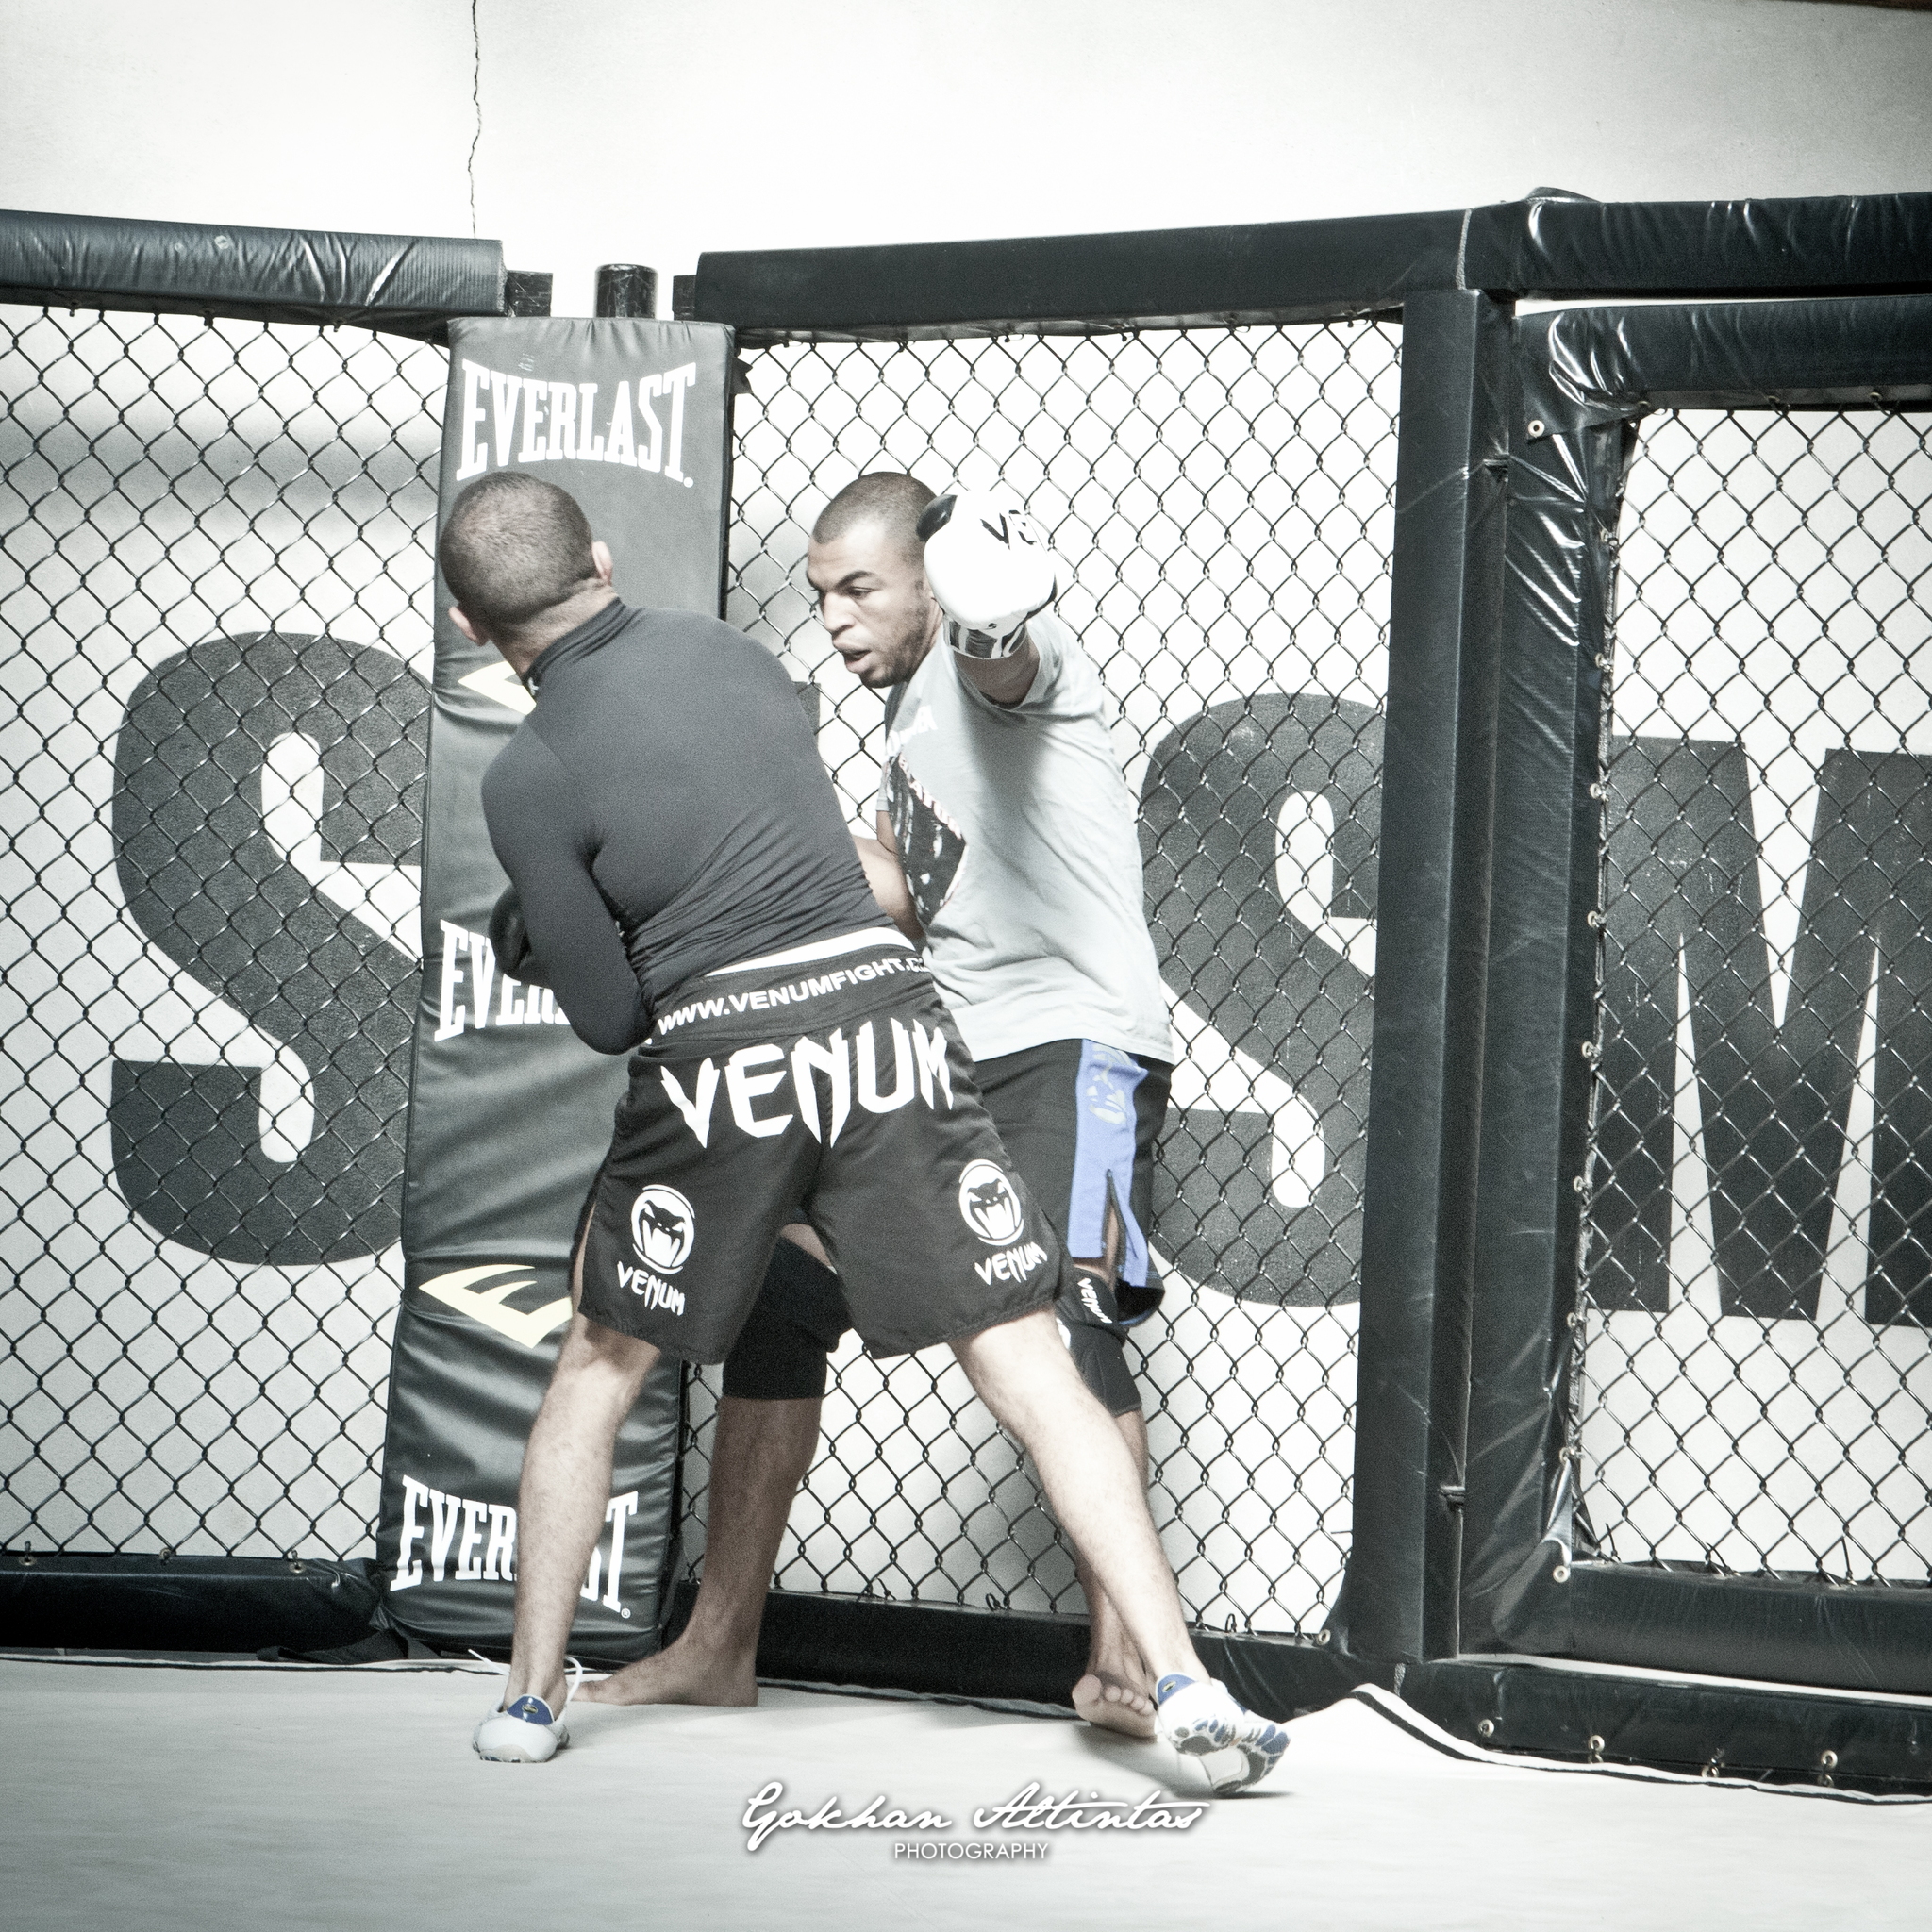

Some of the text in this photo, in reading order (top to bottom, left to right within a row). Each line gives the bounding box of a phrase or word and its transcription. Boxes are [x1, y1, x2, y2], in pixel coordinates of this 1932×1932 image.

[457, 358, 696, 482] EVERLAST
[661, 1017, 955, 1149] VENUM
[617, 1260, 686, 1317] VENUM
[974, 1241, 1048, 1286] VENUM
